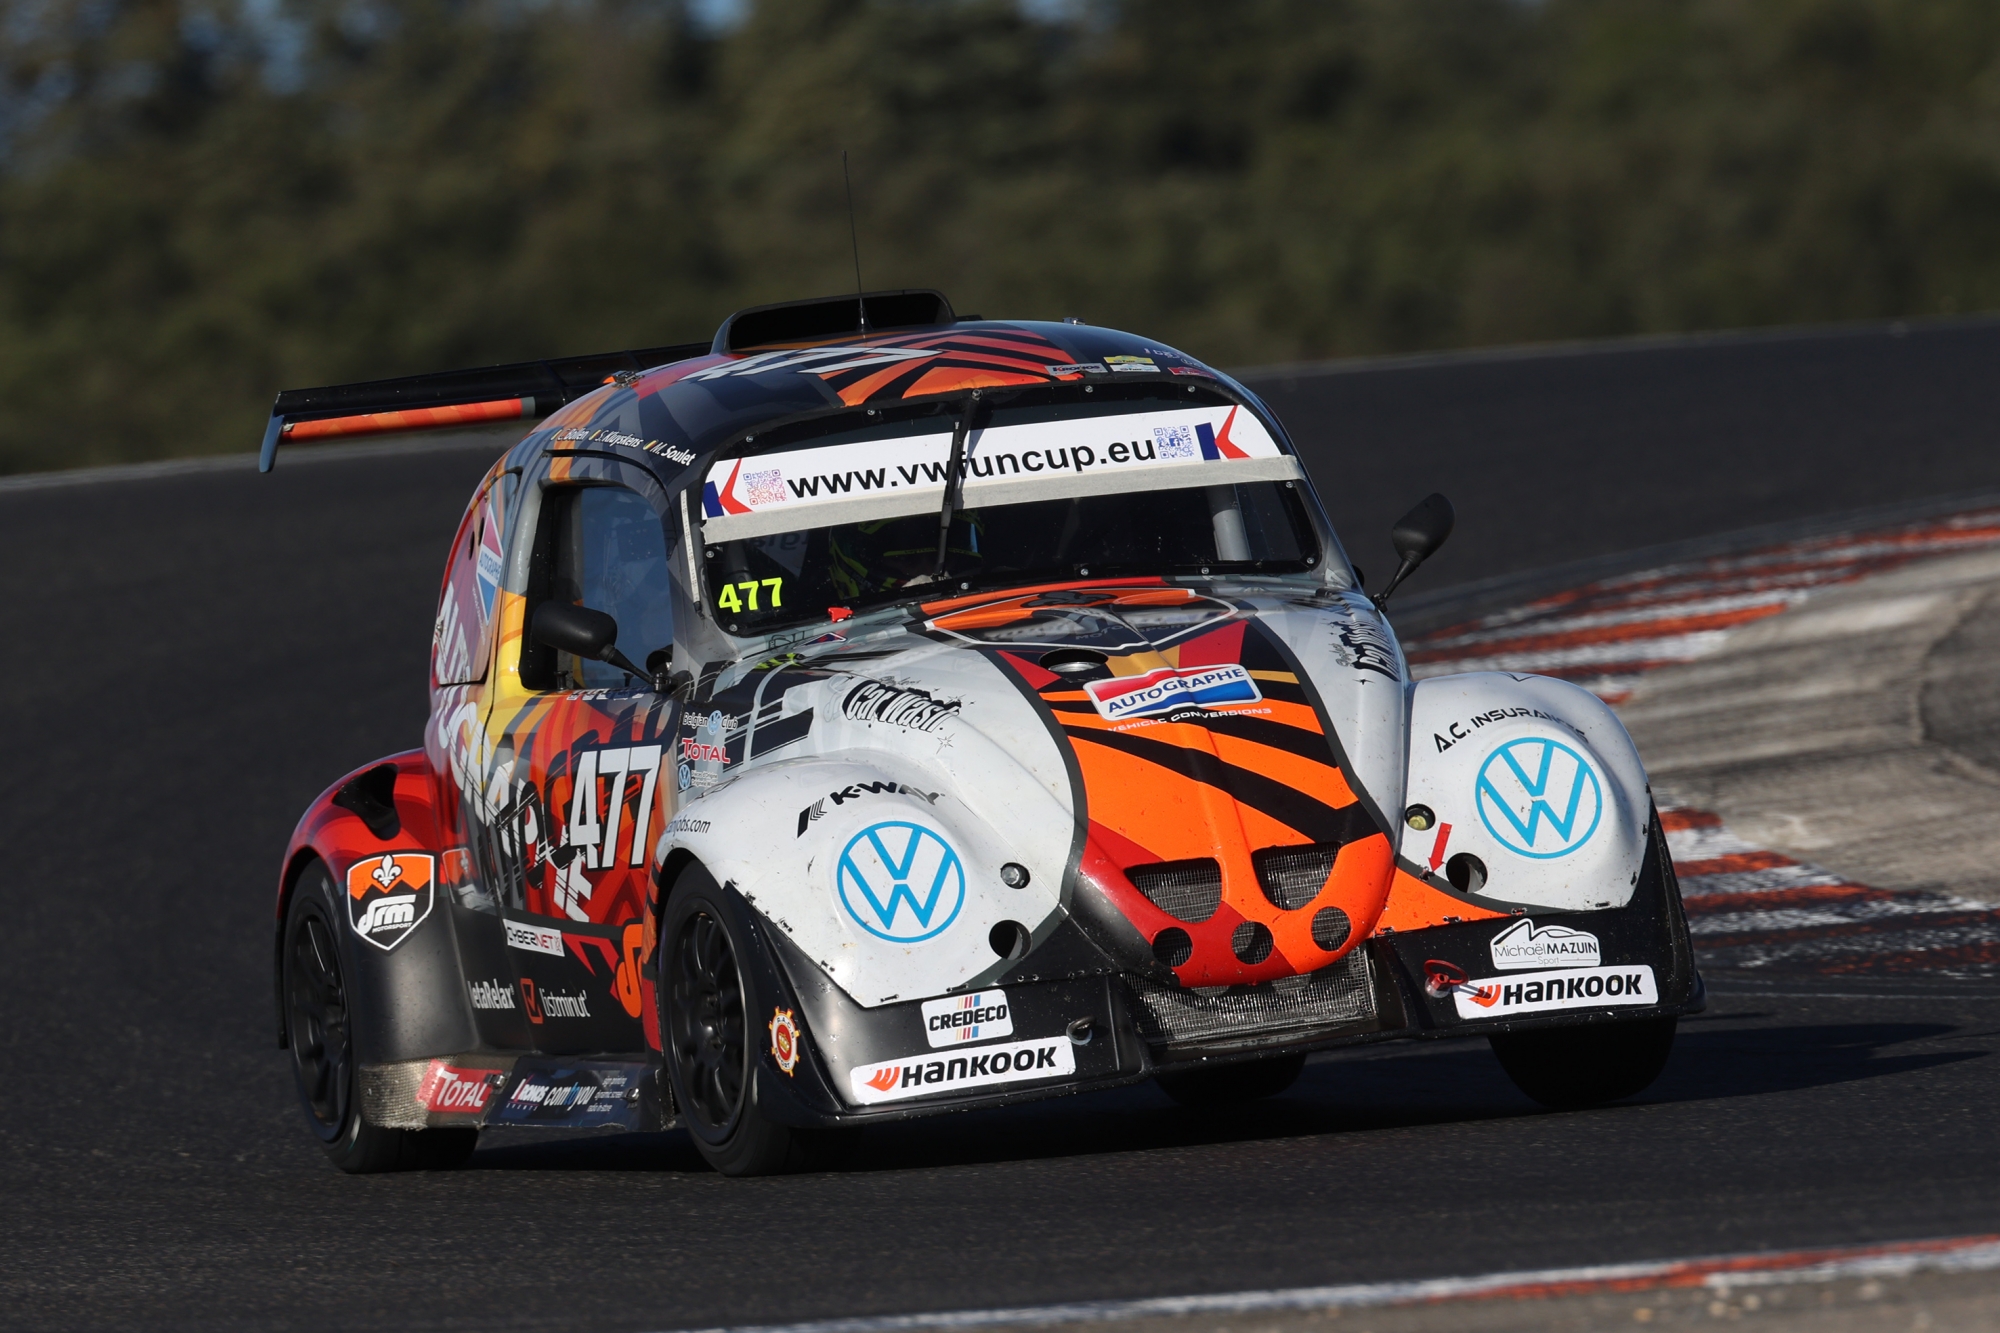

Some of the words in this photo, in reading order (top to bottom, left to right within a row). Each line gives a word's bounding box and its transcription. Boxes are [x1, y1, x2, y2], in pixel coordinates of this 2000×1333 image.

[660, 445, 697, 467] Soulet
[786, 437, 1157, 499] www.vwfuncup.eu
[718, 577, 783, 613] 477
[1075, 623, 1190, 640] MOTOSPORT
[842, 680, 897, 720] Car
[1108, 668, 1246, 713] AUTOGRAPHE
[682, 711, 709, 729] Belgian
[721, 713, 738, 730] Club
[1107, 718, 1167, 732] VEHICLE
[1170, 708, 1273, 722] CONVERSIONS
[682, 737, 731, 765] TOTAL
[1434, 721, 1472, 753] A.C.
[570, 745, 662, 869] 477
[371, 922, 413, 934] MOTORSPORT
[506, 926, 554, 950] CYBERNET
[1537, 956, 1560, 966] Sport
[1547, 942, 1598, 955] MAZUIN
[468, 978, 516, 1009] etaRelax
[929, 1004, 1008, 1032] CREDECO
[436, 1067, 488, 1107] TOTAL
